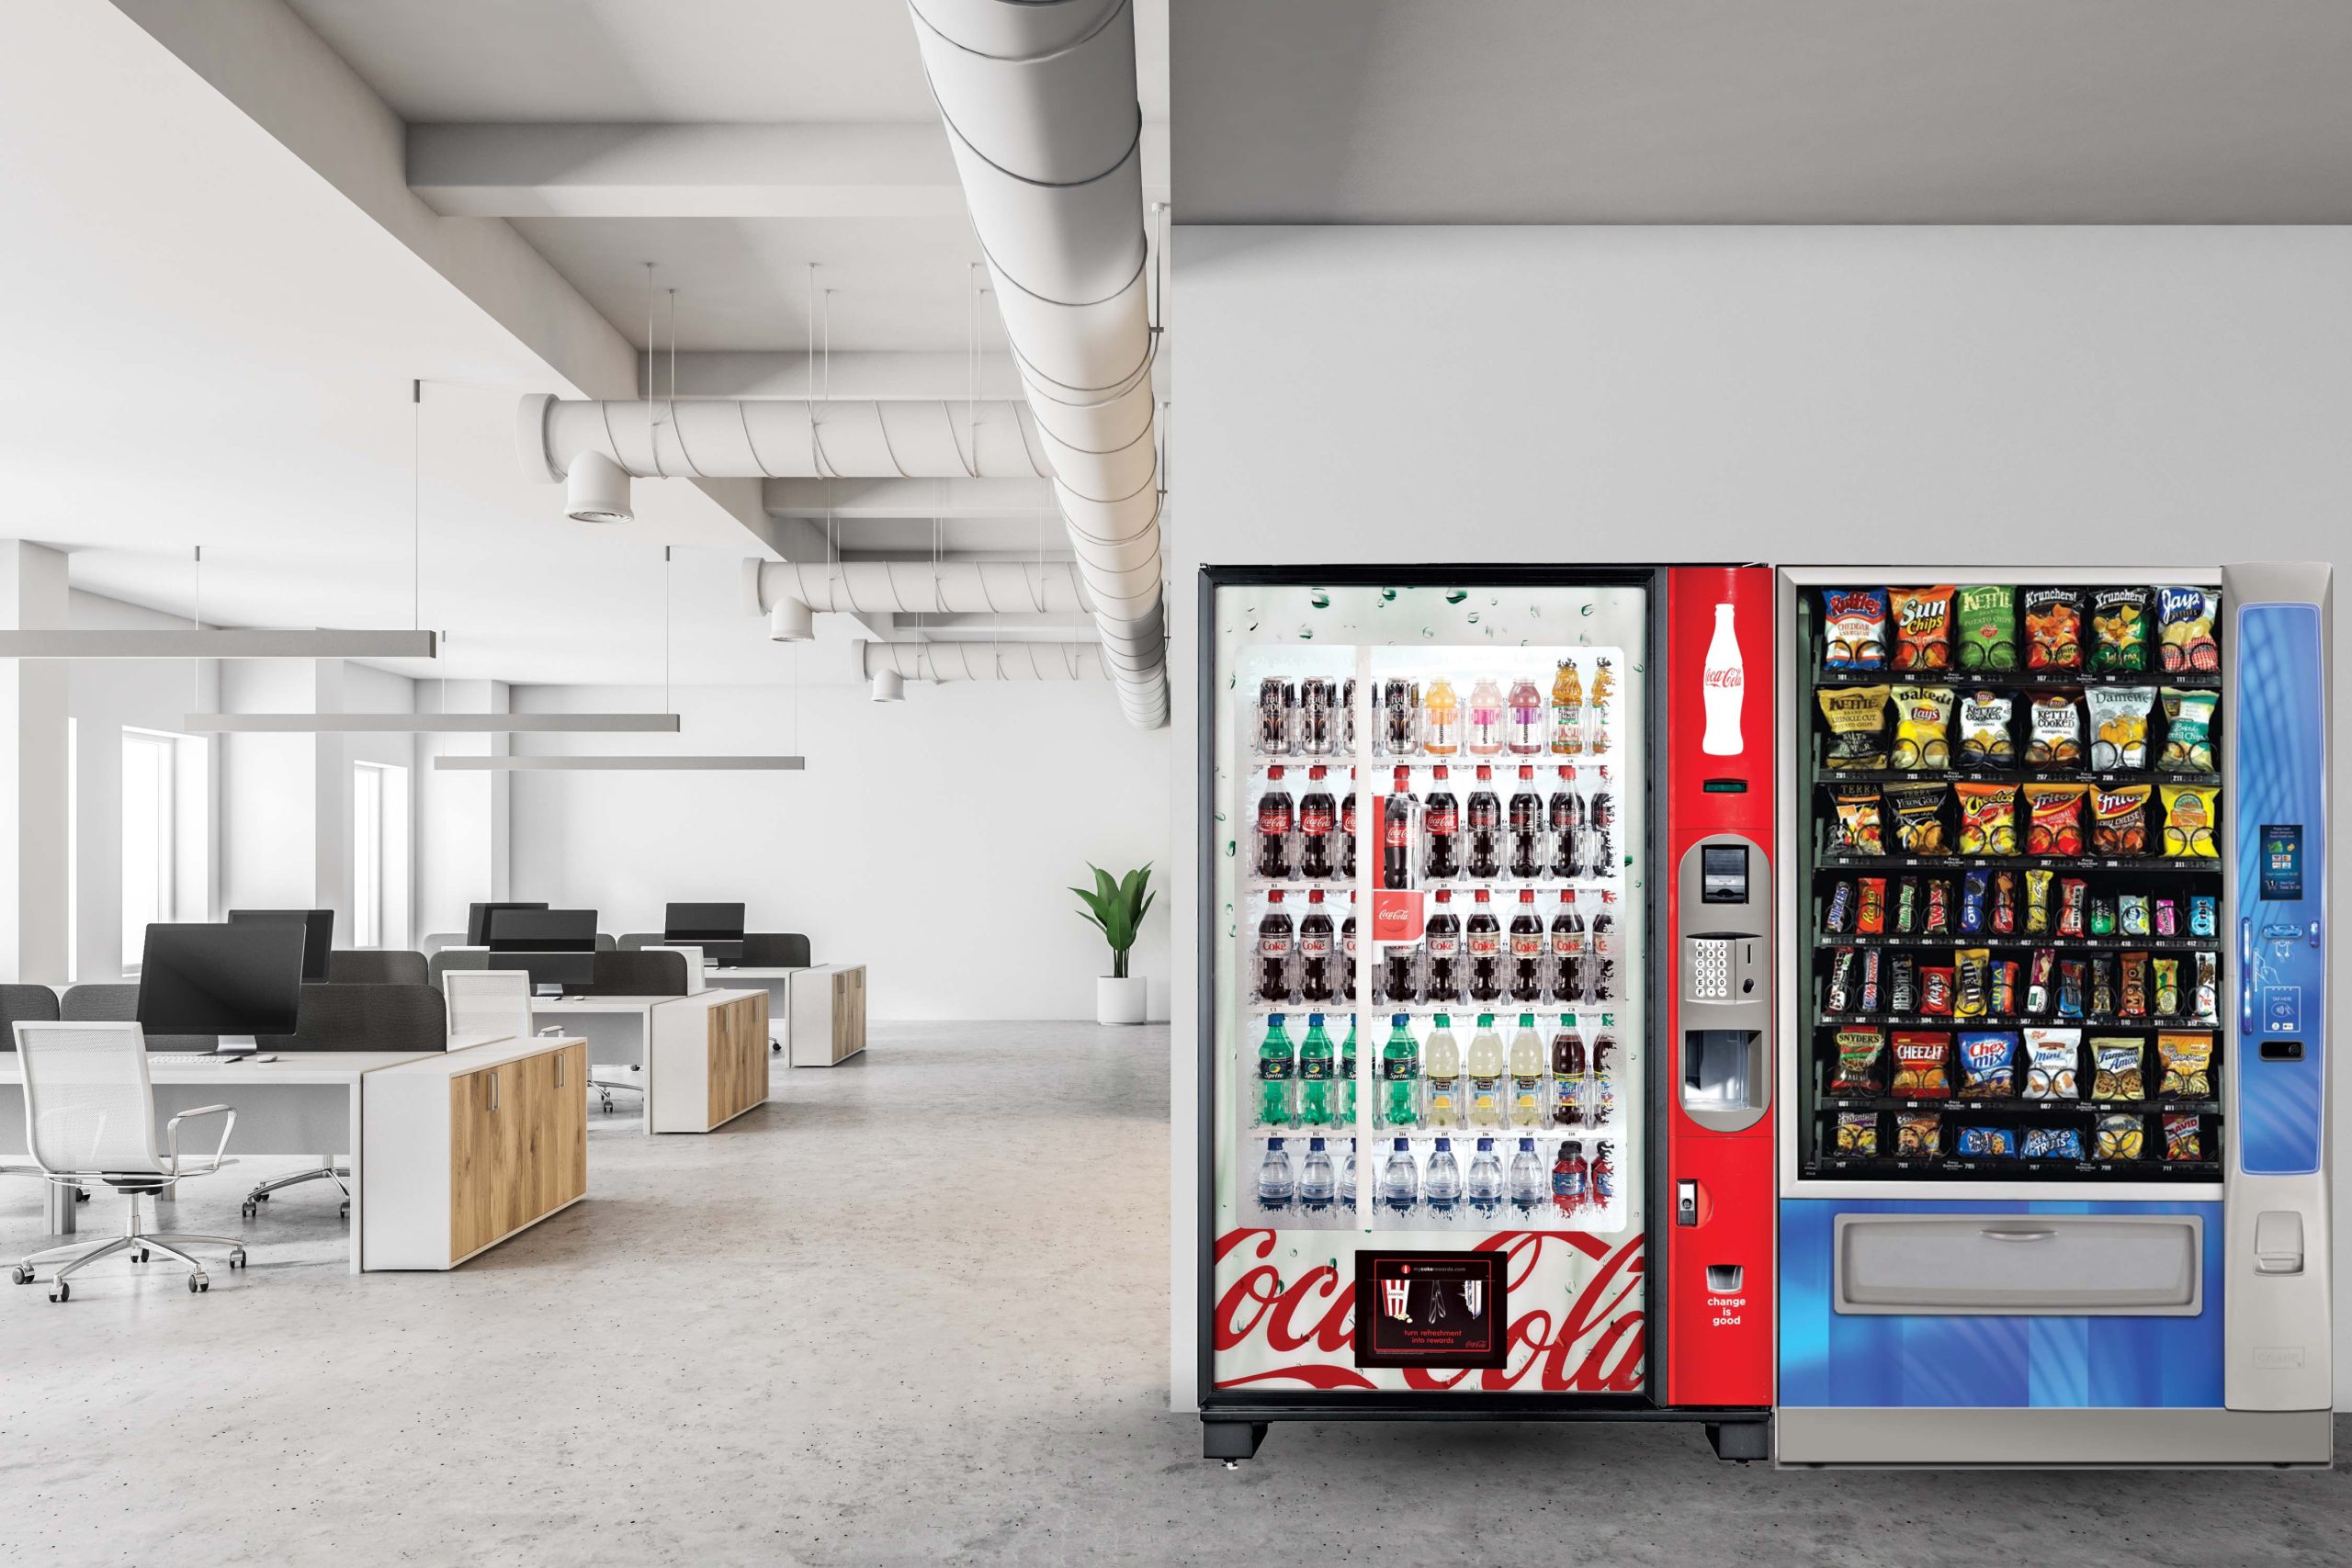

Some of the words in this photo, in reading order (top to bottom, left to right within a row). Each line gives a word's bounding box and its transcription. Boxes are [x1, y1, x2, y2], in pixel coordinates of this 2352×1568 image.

[1830, 591, 1881, 617] Ruffles
[2026, 588, 2076, 607] Krunchers!
[2096, 589, 2147, 608] Krunchers!
[1900, 599, 1946, 626] Sun
[2162, 589, 2201, 625] Jays
[1906, 615, 1944, 635] Chips
[1705, 668, 1742, 688] Coca-Cola
[1900, 688, 1951, 705] Baked!
[1863, 714, 1876, 722] CUT
[1841, 784, 1879, 795] TERRA
[1966, 792, 2015, 816] Cheetos
[2114, 813, 2140, 825] CHEESE
[1829, 886, 1849, 925] SNICKERS
[1380, 909, 1409, 920] Coca-Cola
[1262, 940, 1286, 952] Coke
[1302, 940, 1325, 951] Coke
[1430, 940, 1454, 950] Coke
[1472, 940, 1496, 951] Coke
[1515, 941, 1539, 952] Coke
[1556, 940, 1580, 951] Coke
[1969, 1041, 2007, 1056] Chex
[1973, 1051, 2005, 1067] mix
[2034, 1051, 2062, 1063] Mini
[2097, 1048, 2138, 1066] Famous
[2109, 1056, 2138, 1071] Amos
[1707, 1297, 1746, 1307] change
[1723, 1307, 1731, 1315] is
[1713, 1315, 1740, 1325] good
